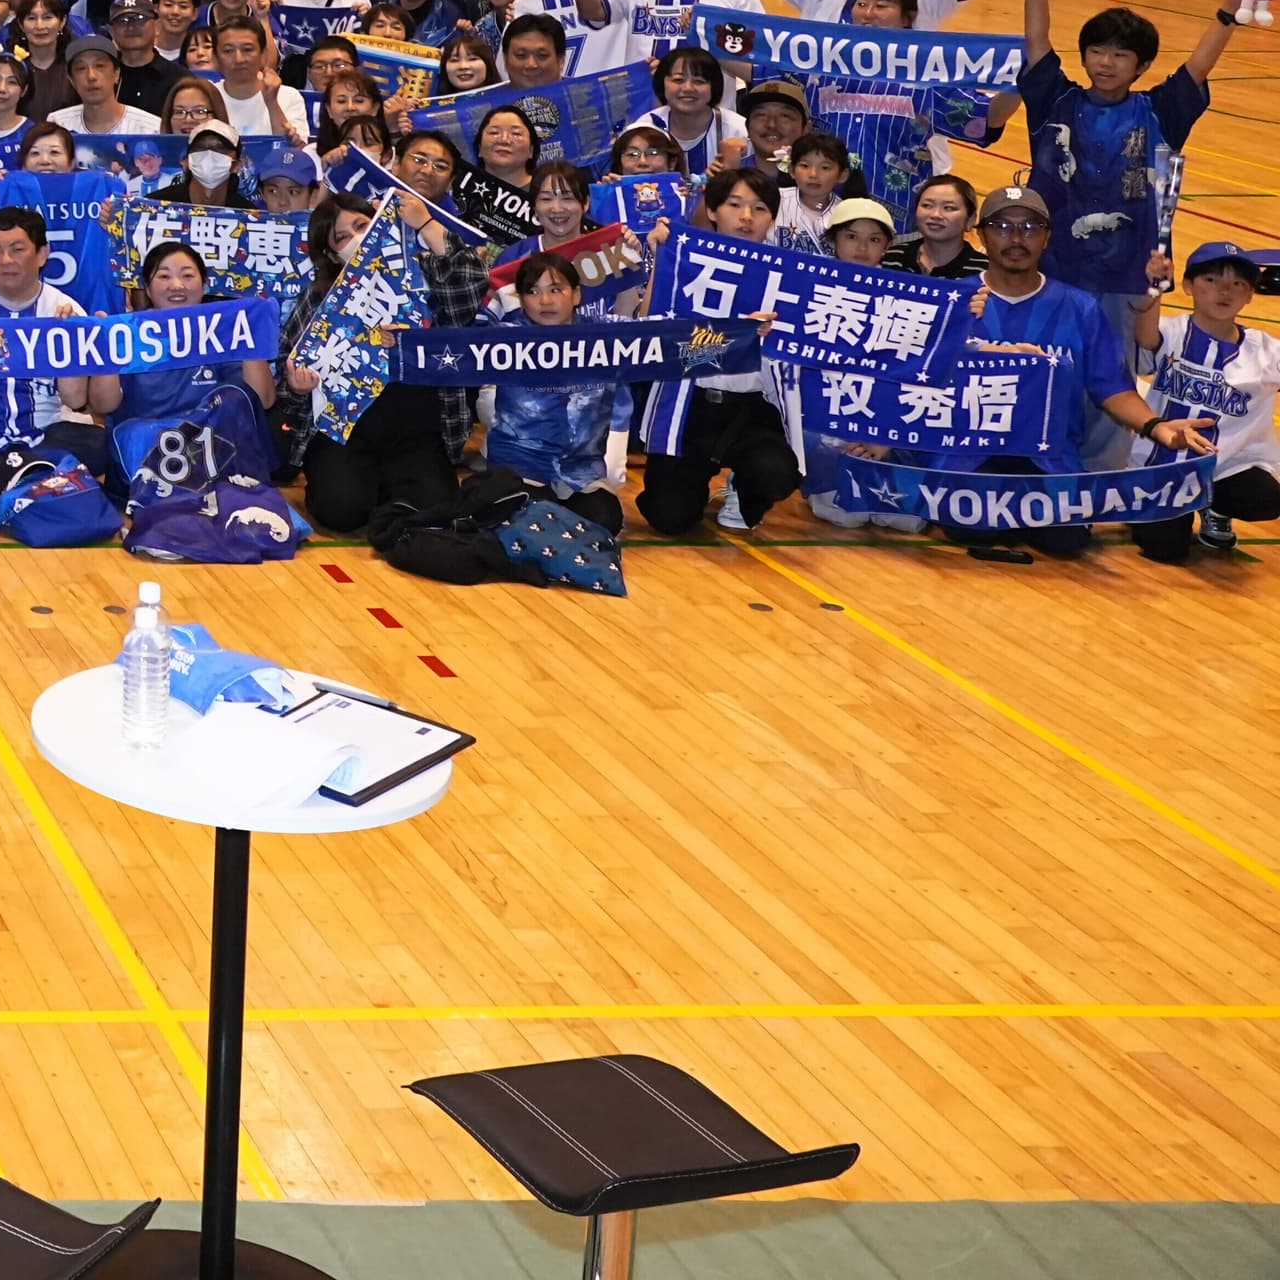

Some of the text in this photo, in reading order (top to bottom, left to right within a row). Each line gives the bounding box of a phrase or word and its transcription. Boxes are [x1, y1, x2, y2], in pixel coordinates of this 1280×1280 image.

[763, 27, 1025, 87] YOKOHAMA
[696, 237, 940, 297] YOKOHAMA DeNA BAYSTARS
[682, 251, 939, 362] 石上泰輝
[14, 309, 255, 370] YOKOSUKA
[417, 345, 425, 368] I
[469, 336, 665, 372] YOKOHAMA
[777, 340, 889, 372] ISHIKAMI
[1153, 356, 1253, 418] BAYSTARS
[828, 420, 1007, 448] SHUGO MAKI
[919, 472, 1202, 529] YOKOHAMA
